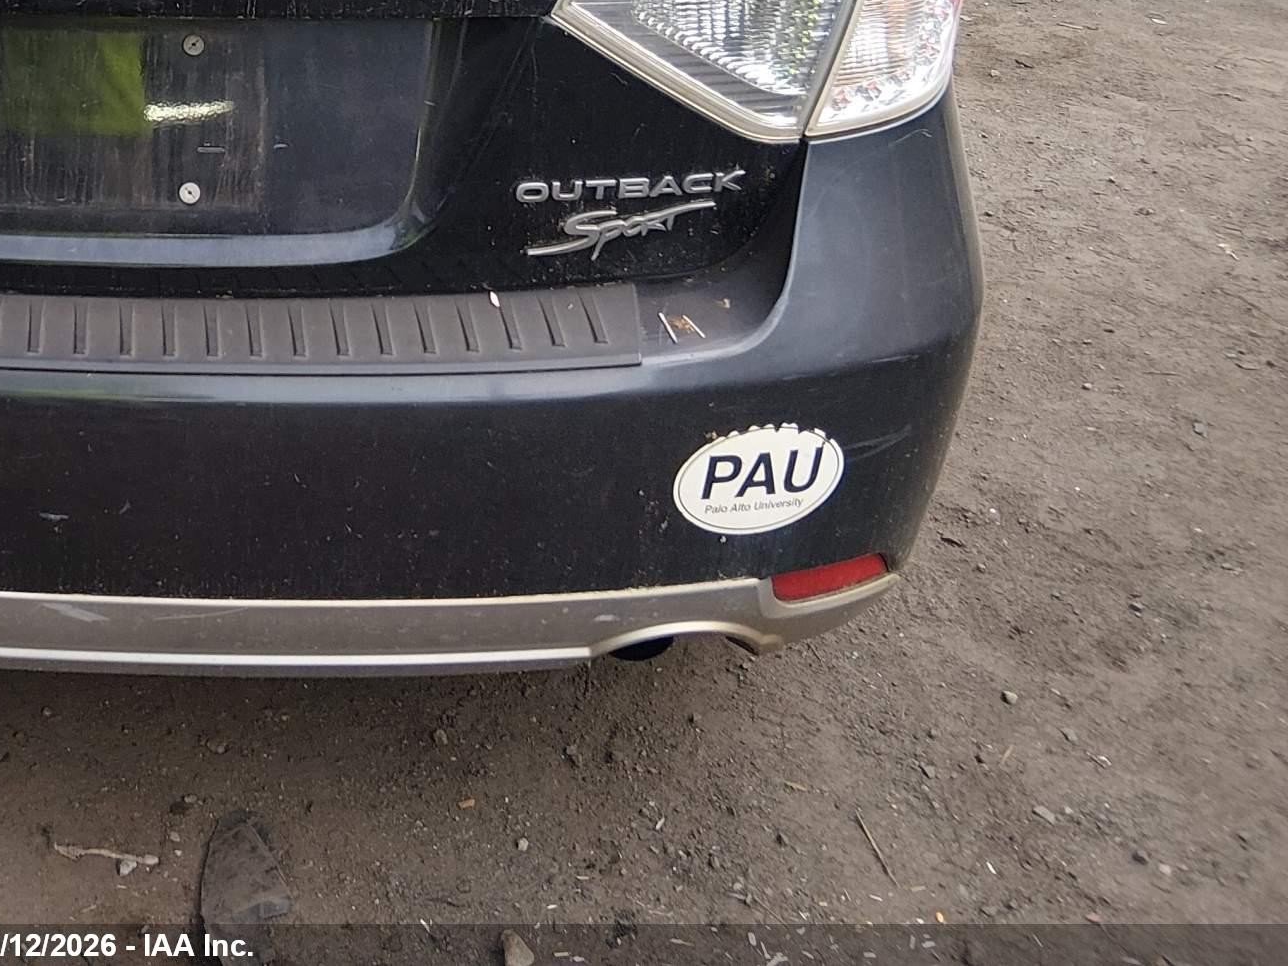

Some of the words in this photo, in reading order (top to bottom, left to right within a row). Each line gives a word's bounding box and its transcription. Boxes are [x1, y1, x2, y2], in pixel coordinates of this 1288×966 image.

[515, 169, 746, 203] OUTBACK
[701, 446, 824, 500] PAU
[705, 504, 728, 514] Palo
[730, 503, 751, 513] Alto
[754, 498, 804, 511] University
